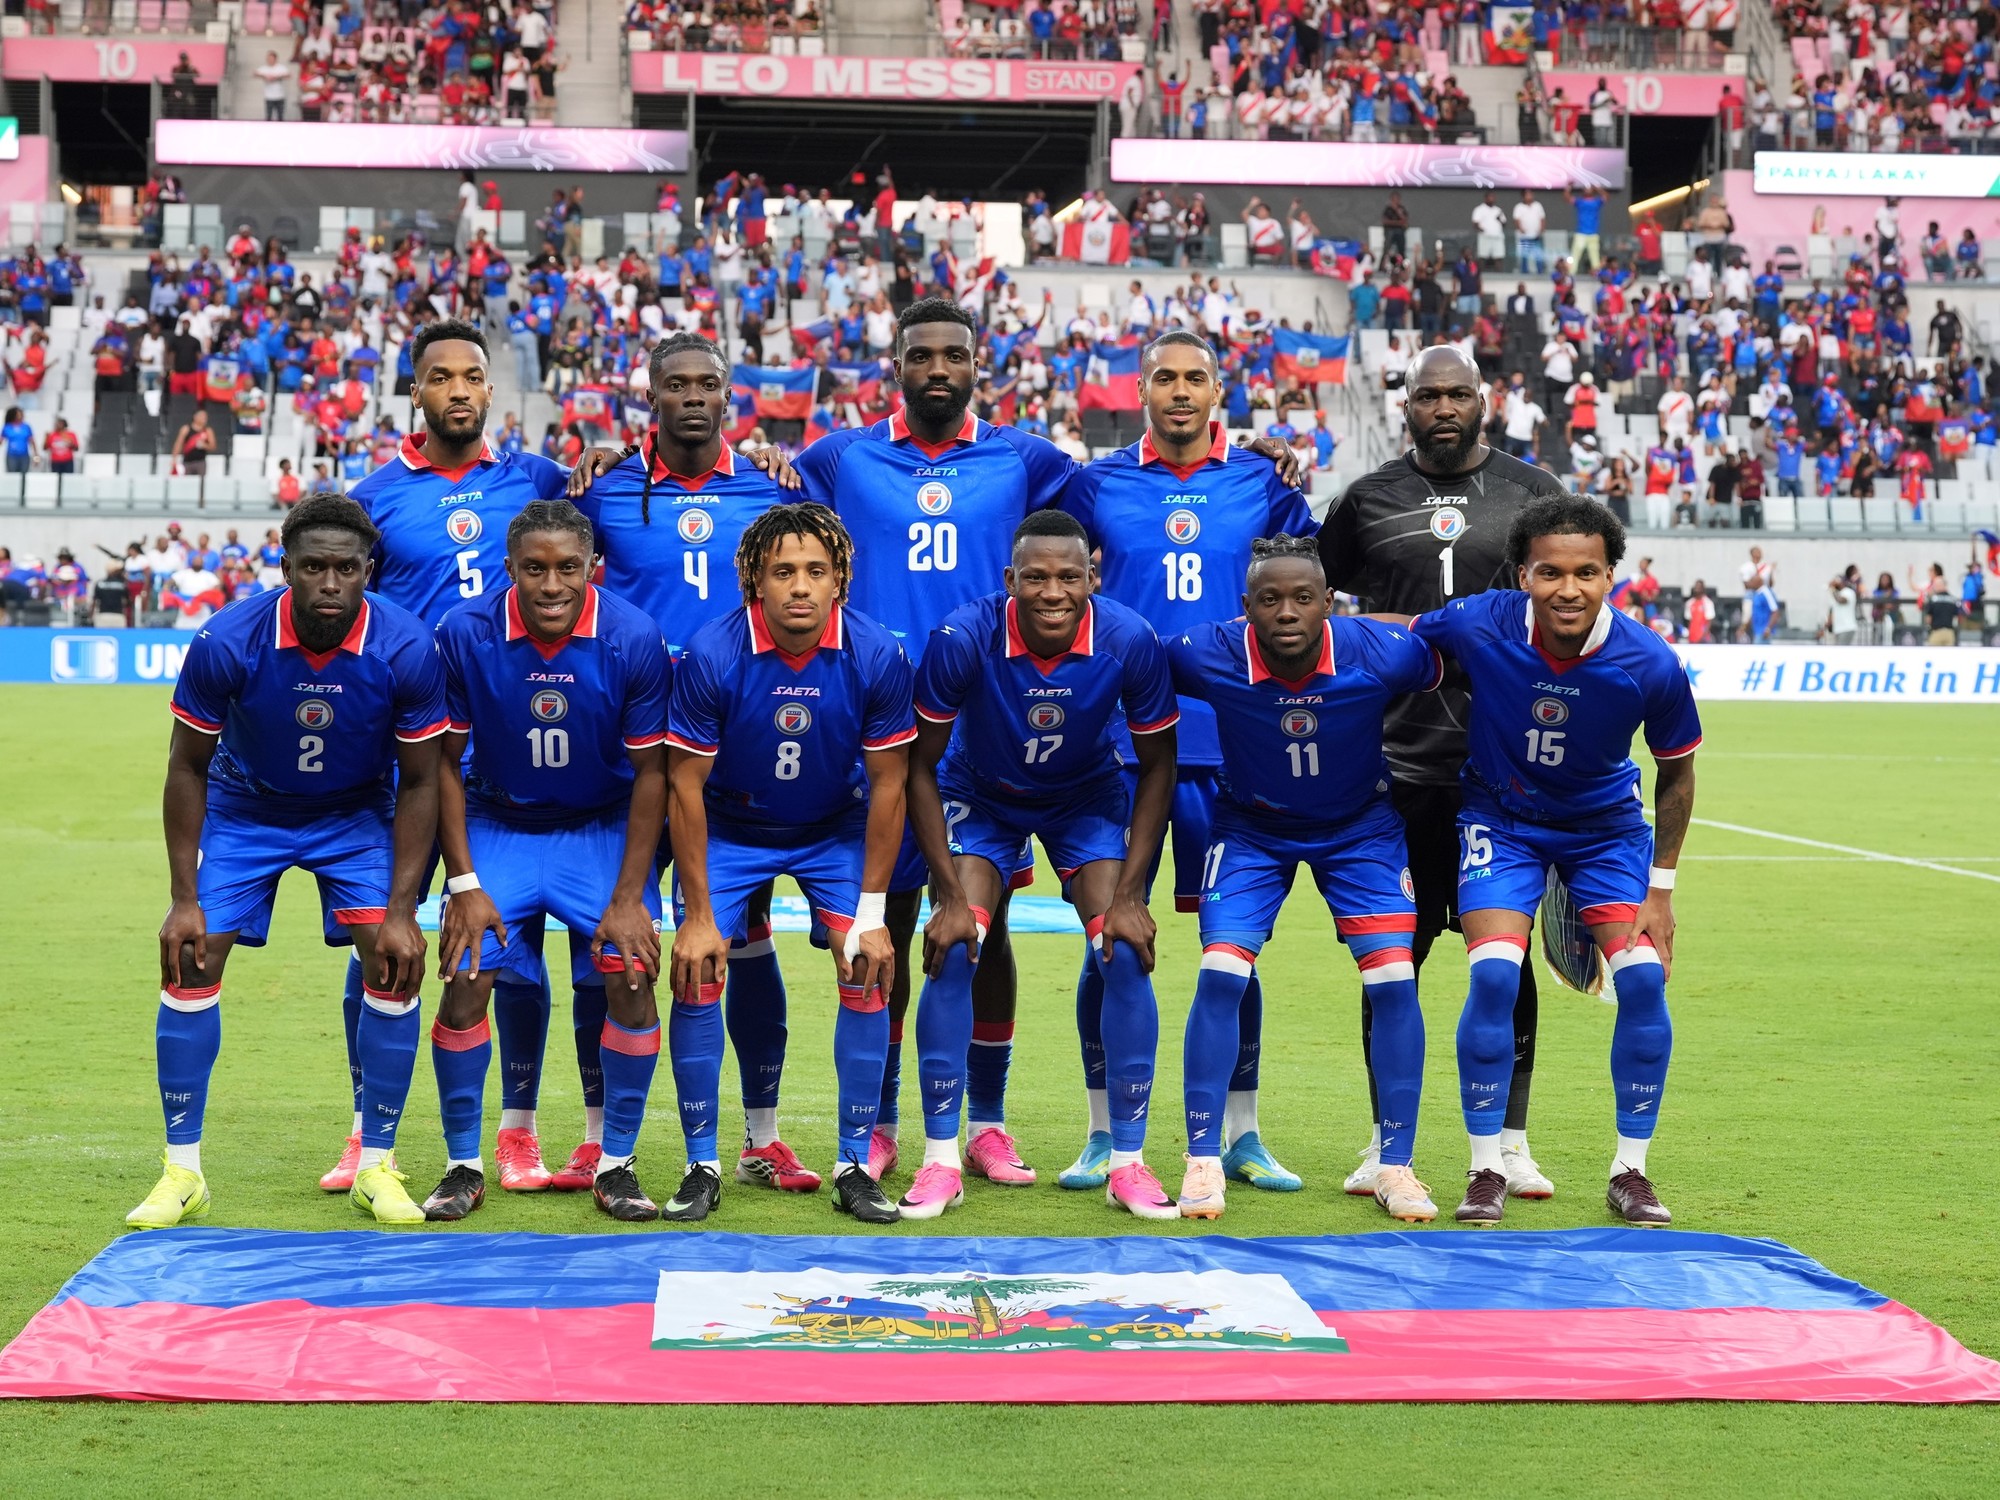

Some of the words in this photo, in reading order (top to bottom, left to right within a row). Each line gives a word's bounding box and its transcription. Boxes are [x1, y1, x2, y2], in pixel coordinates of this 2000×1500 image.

[94, 42, 137, 80] 10
[662, 54, 788, 95] LEO
[812, 58, 1010, 99] MESSI
[1025, 70, 1116, 91] STAND
[1623, 75, 1663, 112] 10
[911, 468, 958, 477] SAETA
[437, 491, 483, 508] SAETA
[671, 495, 720, 505] SAETA
[1161, 494, 1208, 504] SAETA
[1420, 496, 1468, 506] SAETA
[907, 522, 958, 572] 20
[456, 550, 483, 599] 5
[684, 550, 708, 600] 4
[1162, 552, 1202, 602] 18
[1438, 547, 1454, 596] 1
[525, 672, 575, 684] SAETA
[1741, 660, 1787, 692] #1
[1799, 661, 1905, 693] Bank
[1920, 661, 1958, 694] in
[292, 682, 343, 694] SAETA
[771, 686, 821, 697] SAETA
[1023, 687, 1073, 698] SAETA
[1531, 681, 1580, 696] SAETA
[1274, 694, 1324, 706] SAETA
[298, 734, 324, 773] 2
[526, 728, 570, 768] 10
[1023, 734, 1064, 764] 17
[1525, 728, 1566, 767] 15
[774, 740, 801, 780] 8
[1285, 742, 1320, 778] 11
[1462, 824, 1492, 870] 15
[1201, 842, 1225, 890] 11
[350, 1066, 362, 1074] FH
[510, 1062, 535, 1072] FHF
[760, 1064, 782, 1074] FHF
[934, 1078, 958, 1090] FHF
[1131, 1080, 1152, 1094] FHF
[1472, 1082, 1498, 1092] FHF
[1632, 1083, 1658, 1092] FHF
[165, 1092, 192, 1103] FHF
[378, 1104, 400, 1116] FHF
[684, 1101, 706, 1112] FHF
[852, 1106, 876, 1114] FHF
[1190, 1110, 1210, 1121] FHF
[1383, 1118, 1402, 1130] FHF
